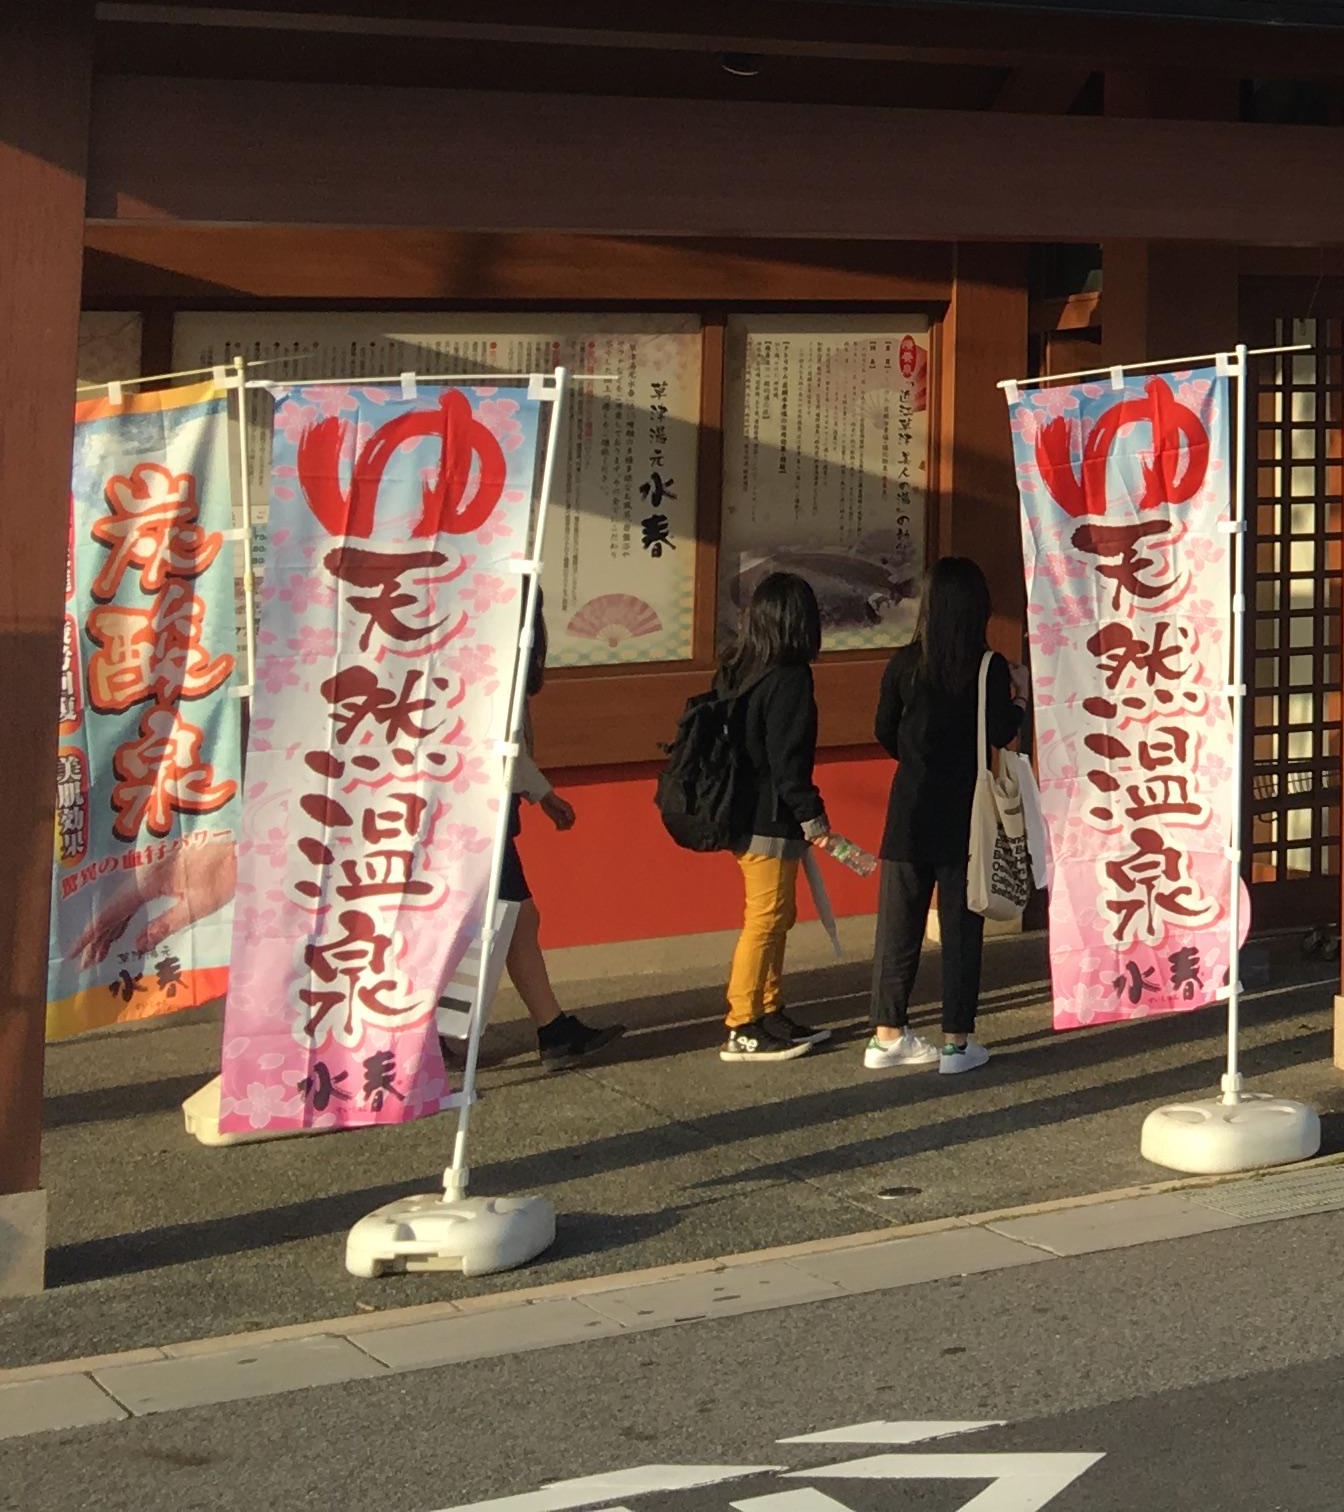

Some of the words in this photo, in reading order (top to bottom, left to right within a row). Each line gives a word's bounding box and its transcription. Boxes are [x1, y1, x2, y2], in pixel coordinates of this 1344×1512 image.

[297, 388, 507, 539] ゆ
[650, 380, 668, 468] 草津湯元
[1035, 374, 1211, 517] ゆ
[638, 471, 678, 558] 水春
[86, 462, 236, 842] 炭酸泉
[1069, 517, 1215, 942] 天然温泉
[56, 754, 84, 861] 美肌効果
[297, 546, 453, 1039] 天然温泉
[60, 827, 233, 901] 驚異の血行パワー
[108, 956, 189, 1003] 水春
[1113, 946, 1204, 1005] 水春
[297, 1050, 406, 1112] 水春
